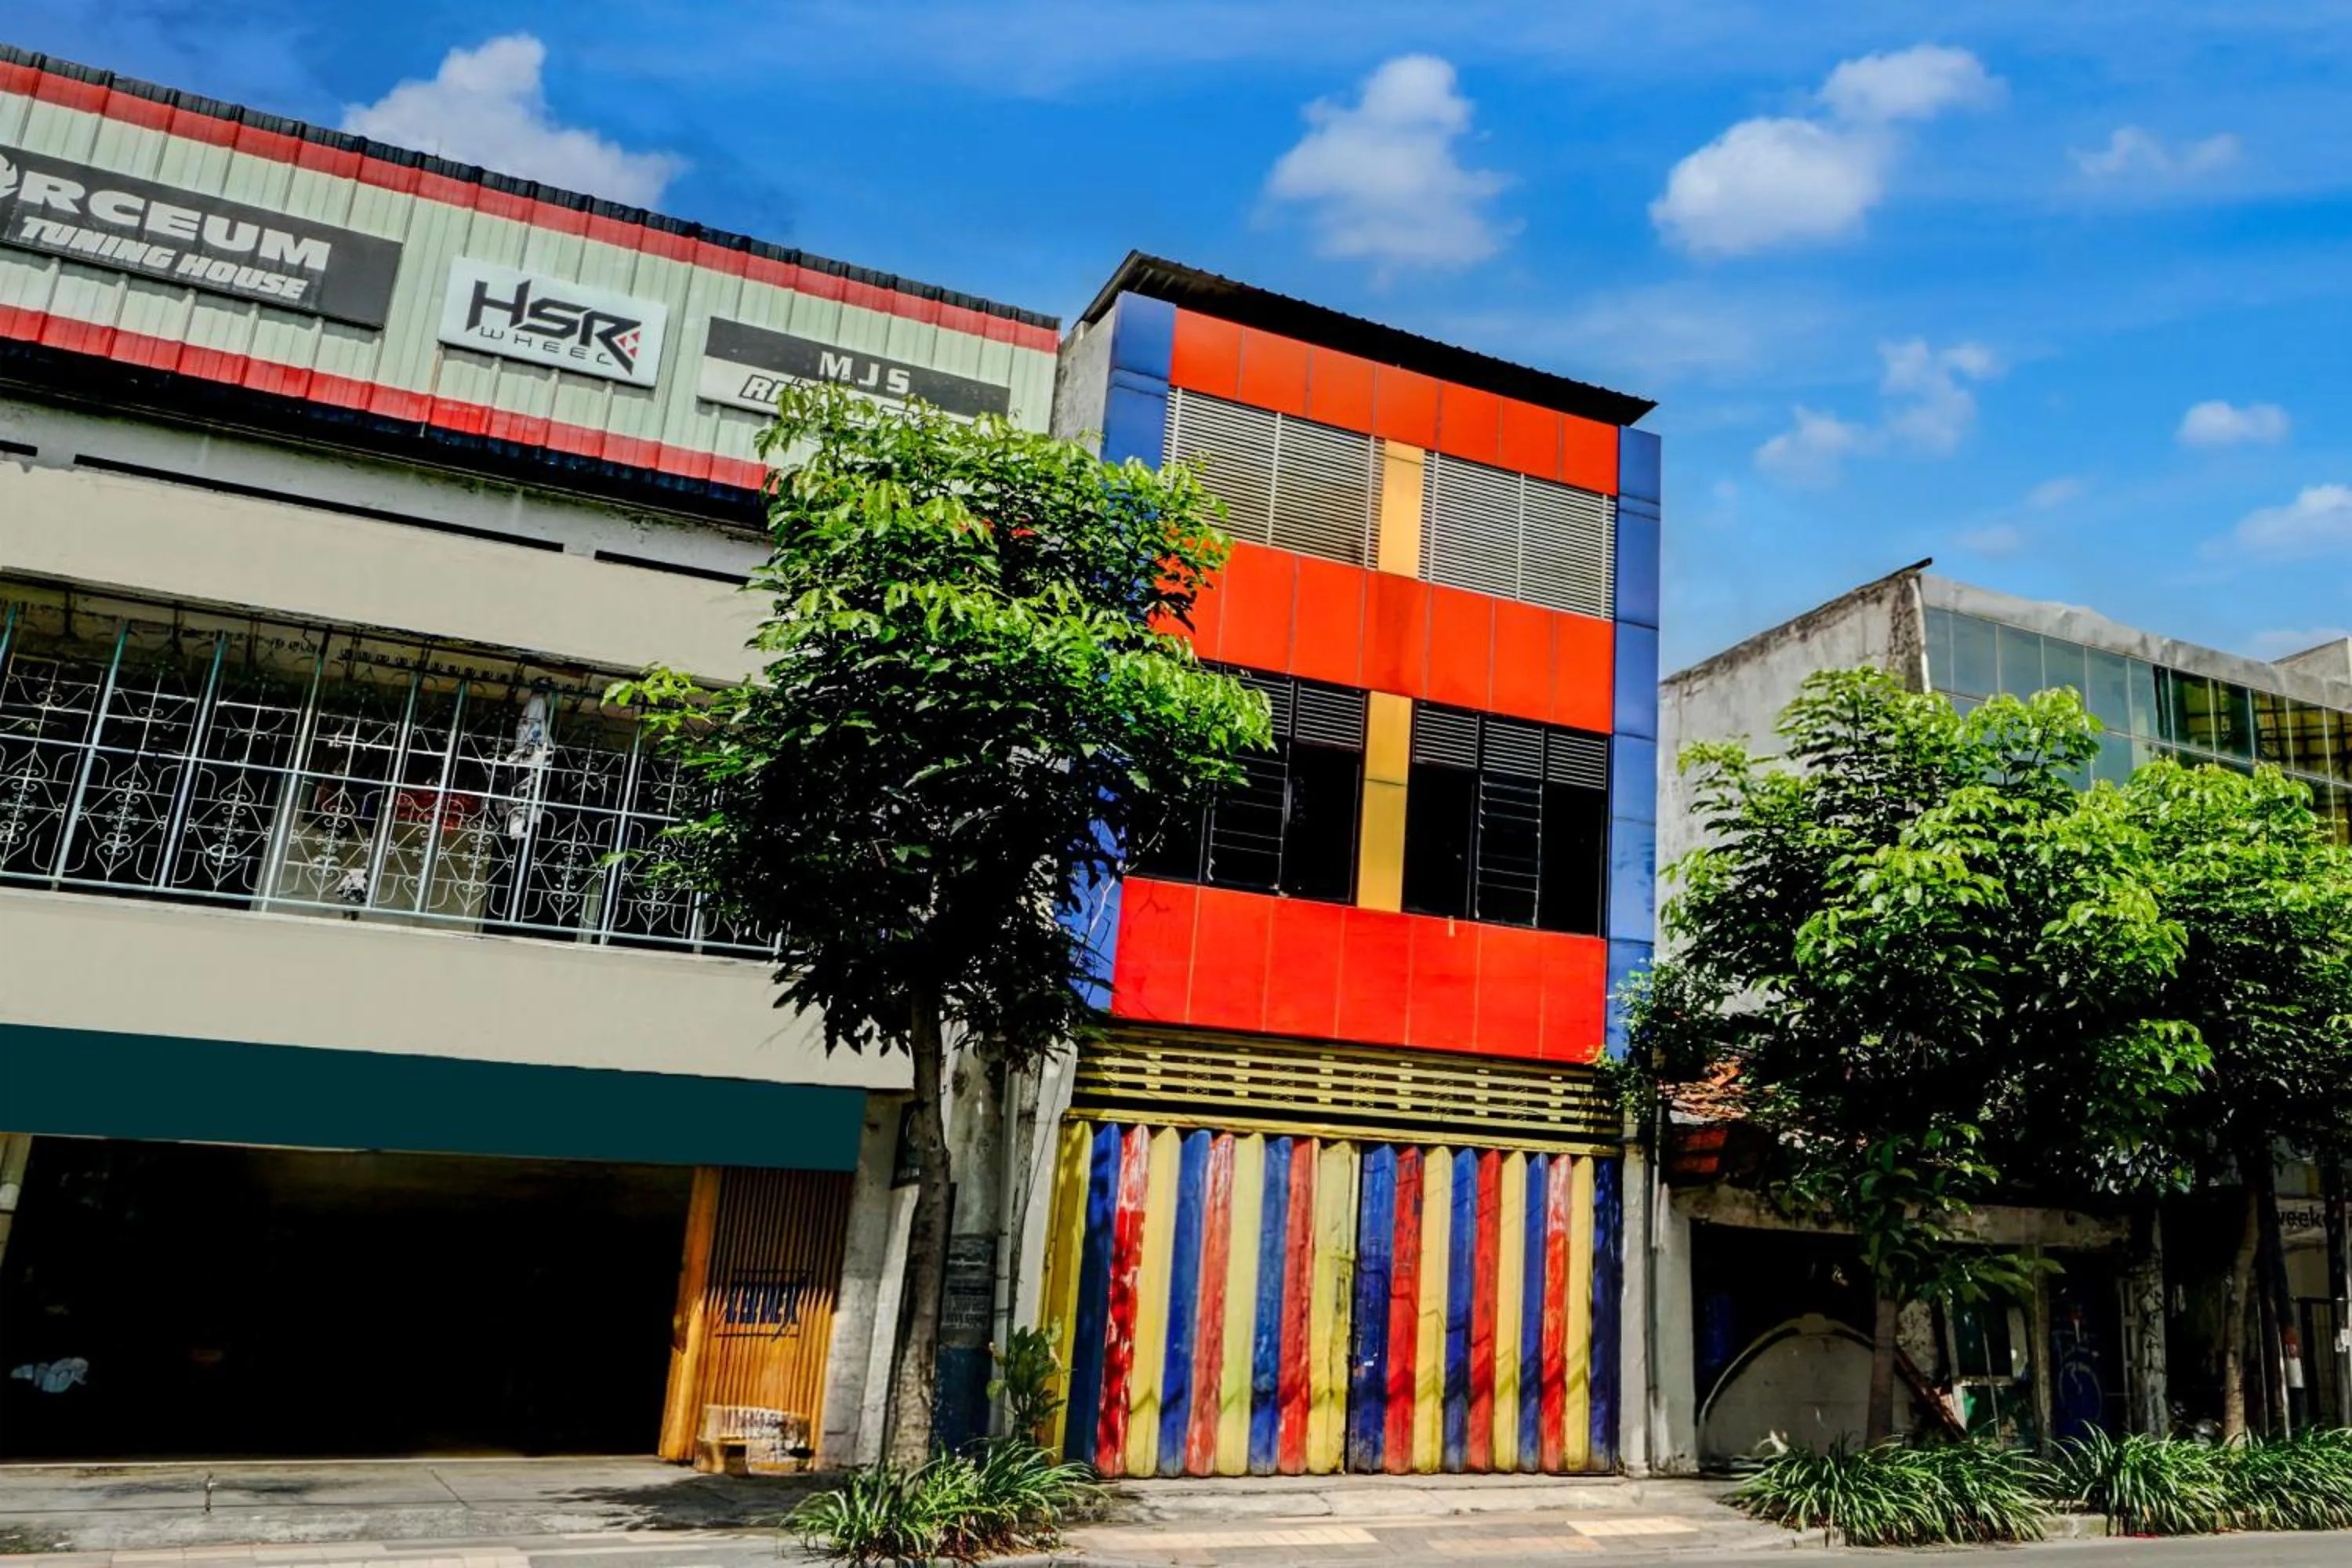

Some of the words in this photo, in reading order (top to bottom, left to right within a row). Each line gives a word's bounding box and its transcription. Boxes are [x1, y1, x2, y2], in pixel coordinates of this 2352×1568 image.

[0, 154, 332, 271] RCEUM
[20, 216, 177, 270] TUNING
[175, 253, 309, 299] HOUSE
[465, 278, 641, 376] HSR
